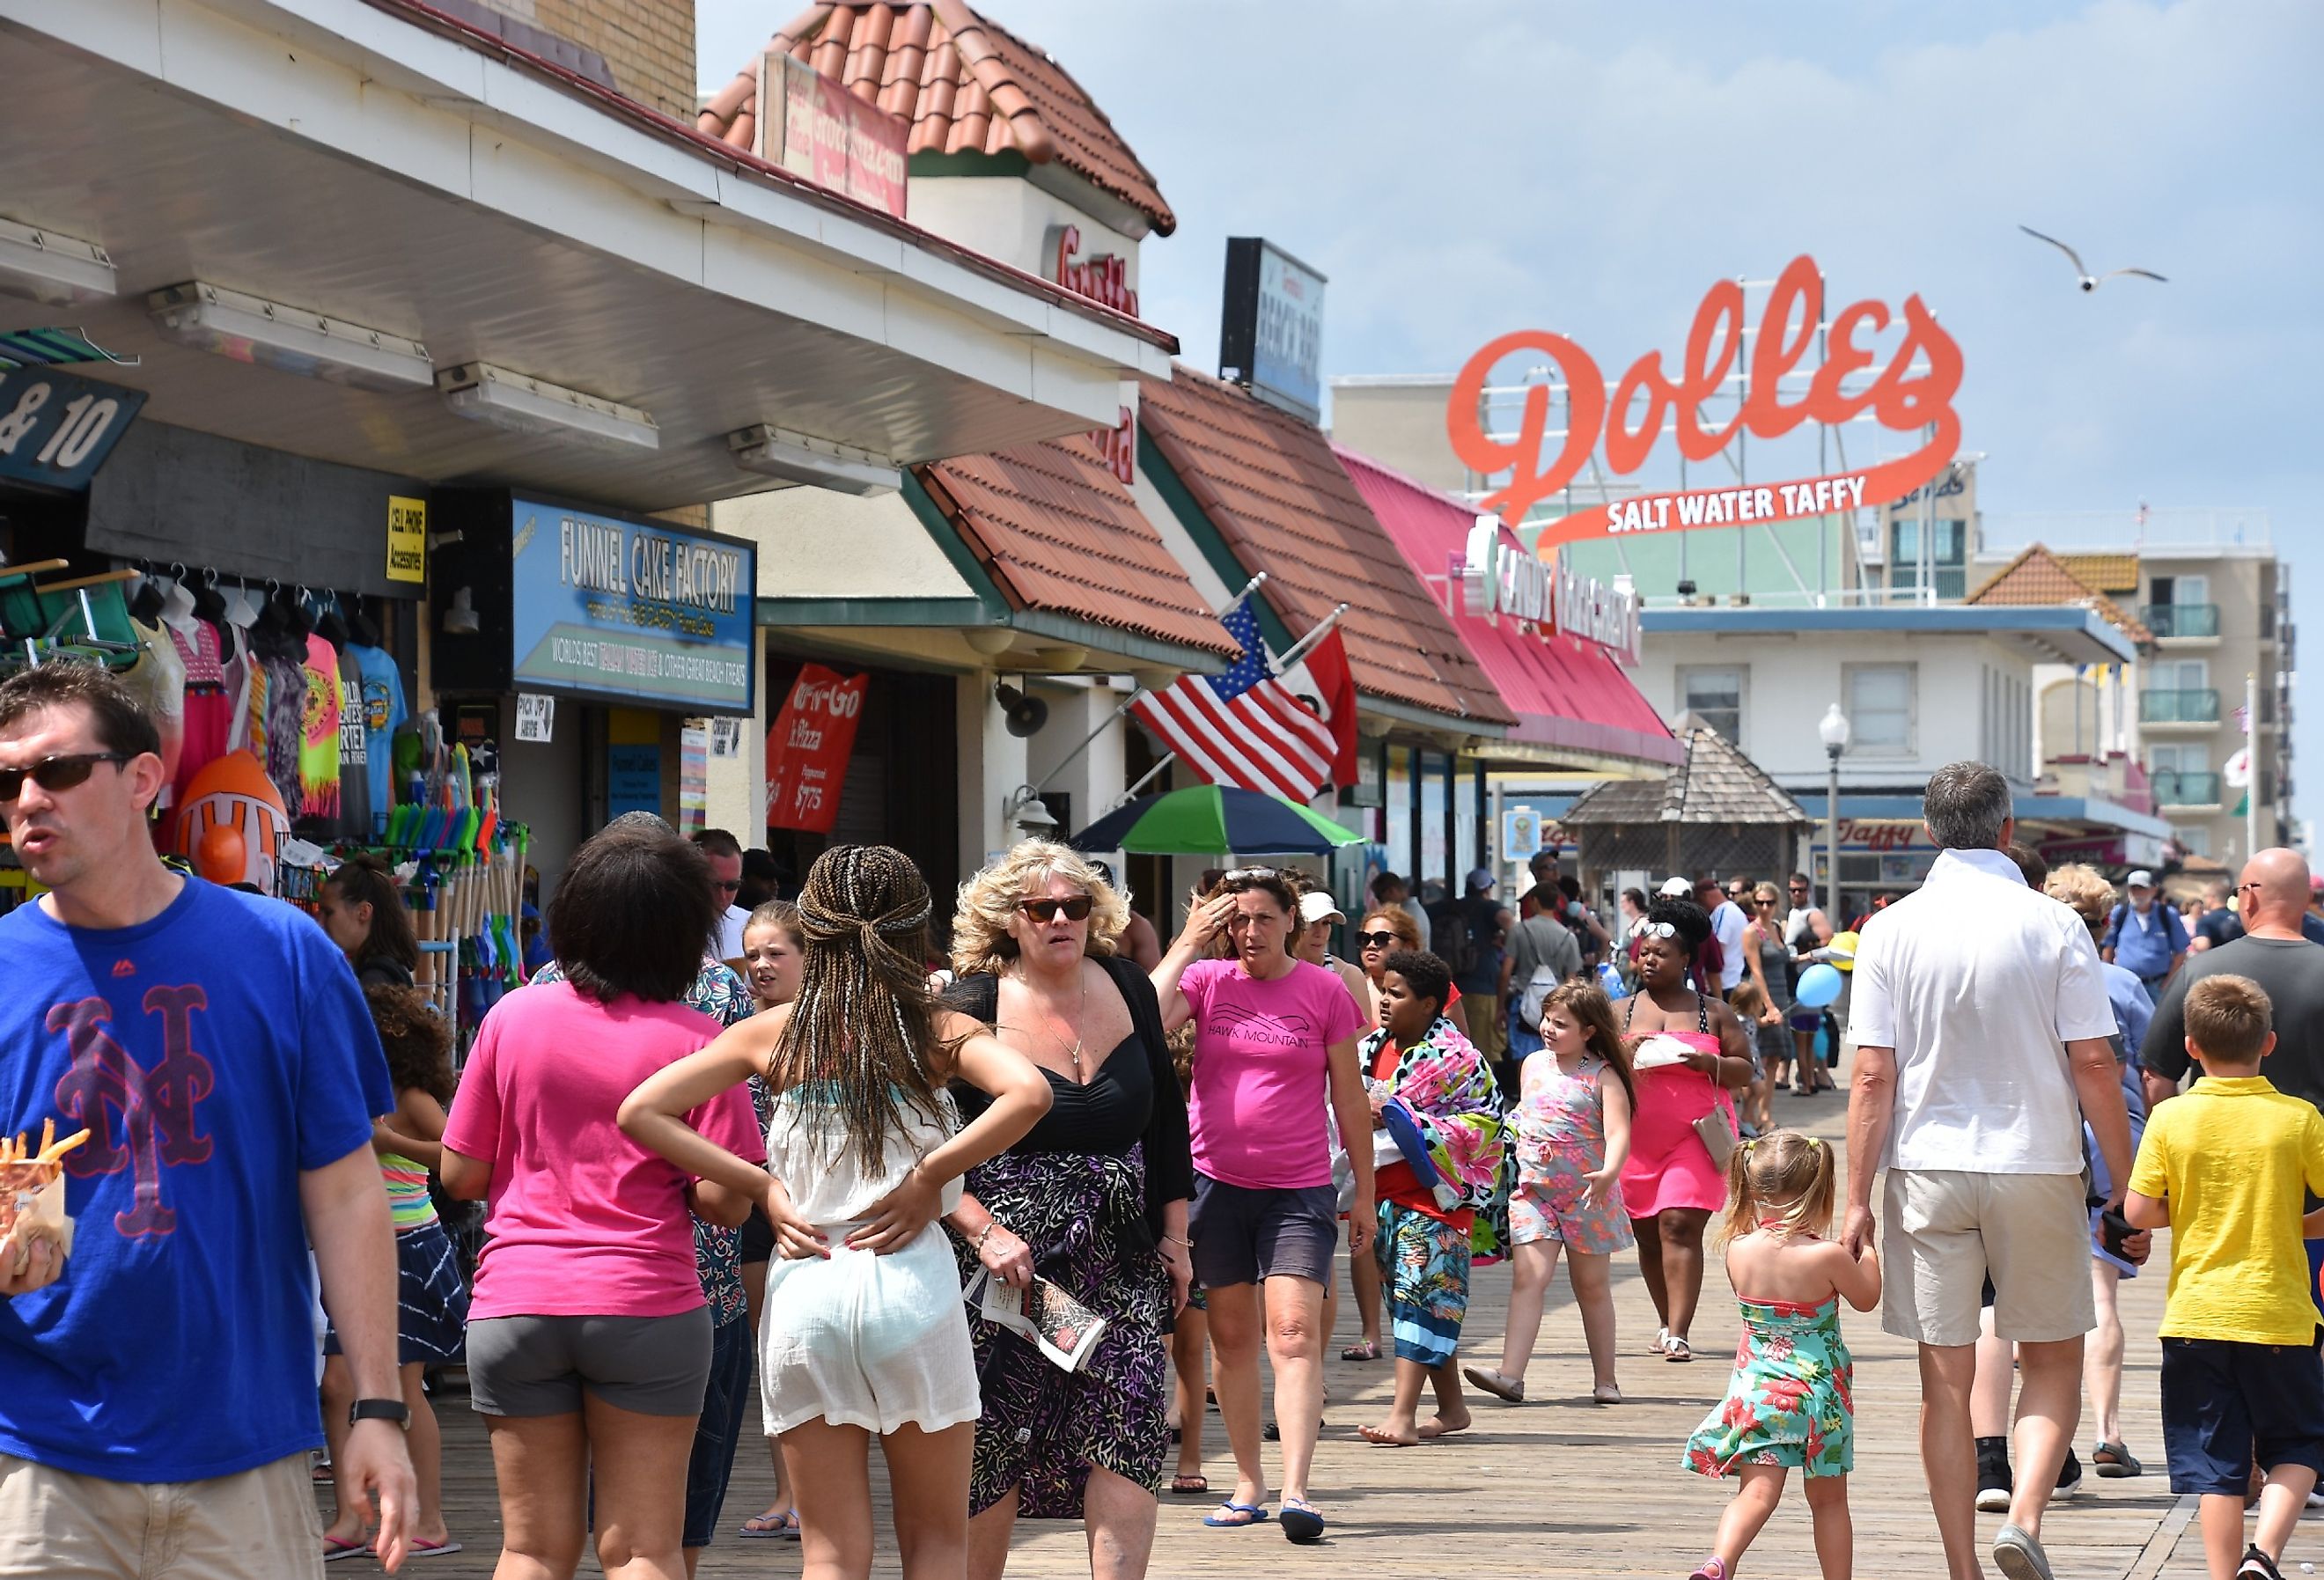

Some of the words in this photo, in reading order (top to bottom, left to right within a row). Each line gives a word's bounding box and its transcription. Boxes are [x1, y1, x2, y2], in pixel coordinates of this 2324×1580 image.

[37, 393, 118, 467] 10
[1607, 497, 1671, 533] SALT
[1676, 486, 1775, 526] WATER
[1778, 474, 1866, 517] TAFFY
[562, 517, 626, 597] FUNNEL
[631, 533, 669, 604] CAKE
[675, 542, 738, 614] FACTORY
[518, 697, 533, 716] PICK
[534, 698, 545, 717] UP
[520, 719, 538, 738] HERE
[1837, 818, 1916, 852] Taffy
[1208, 1025, 1239, 1039] HAWK
[1244, 1030, 1309, 1049] MOUNTAIN
